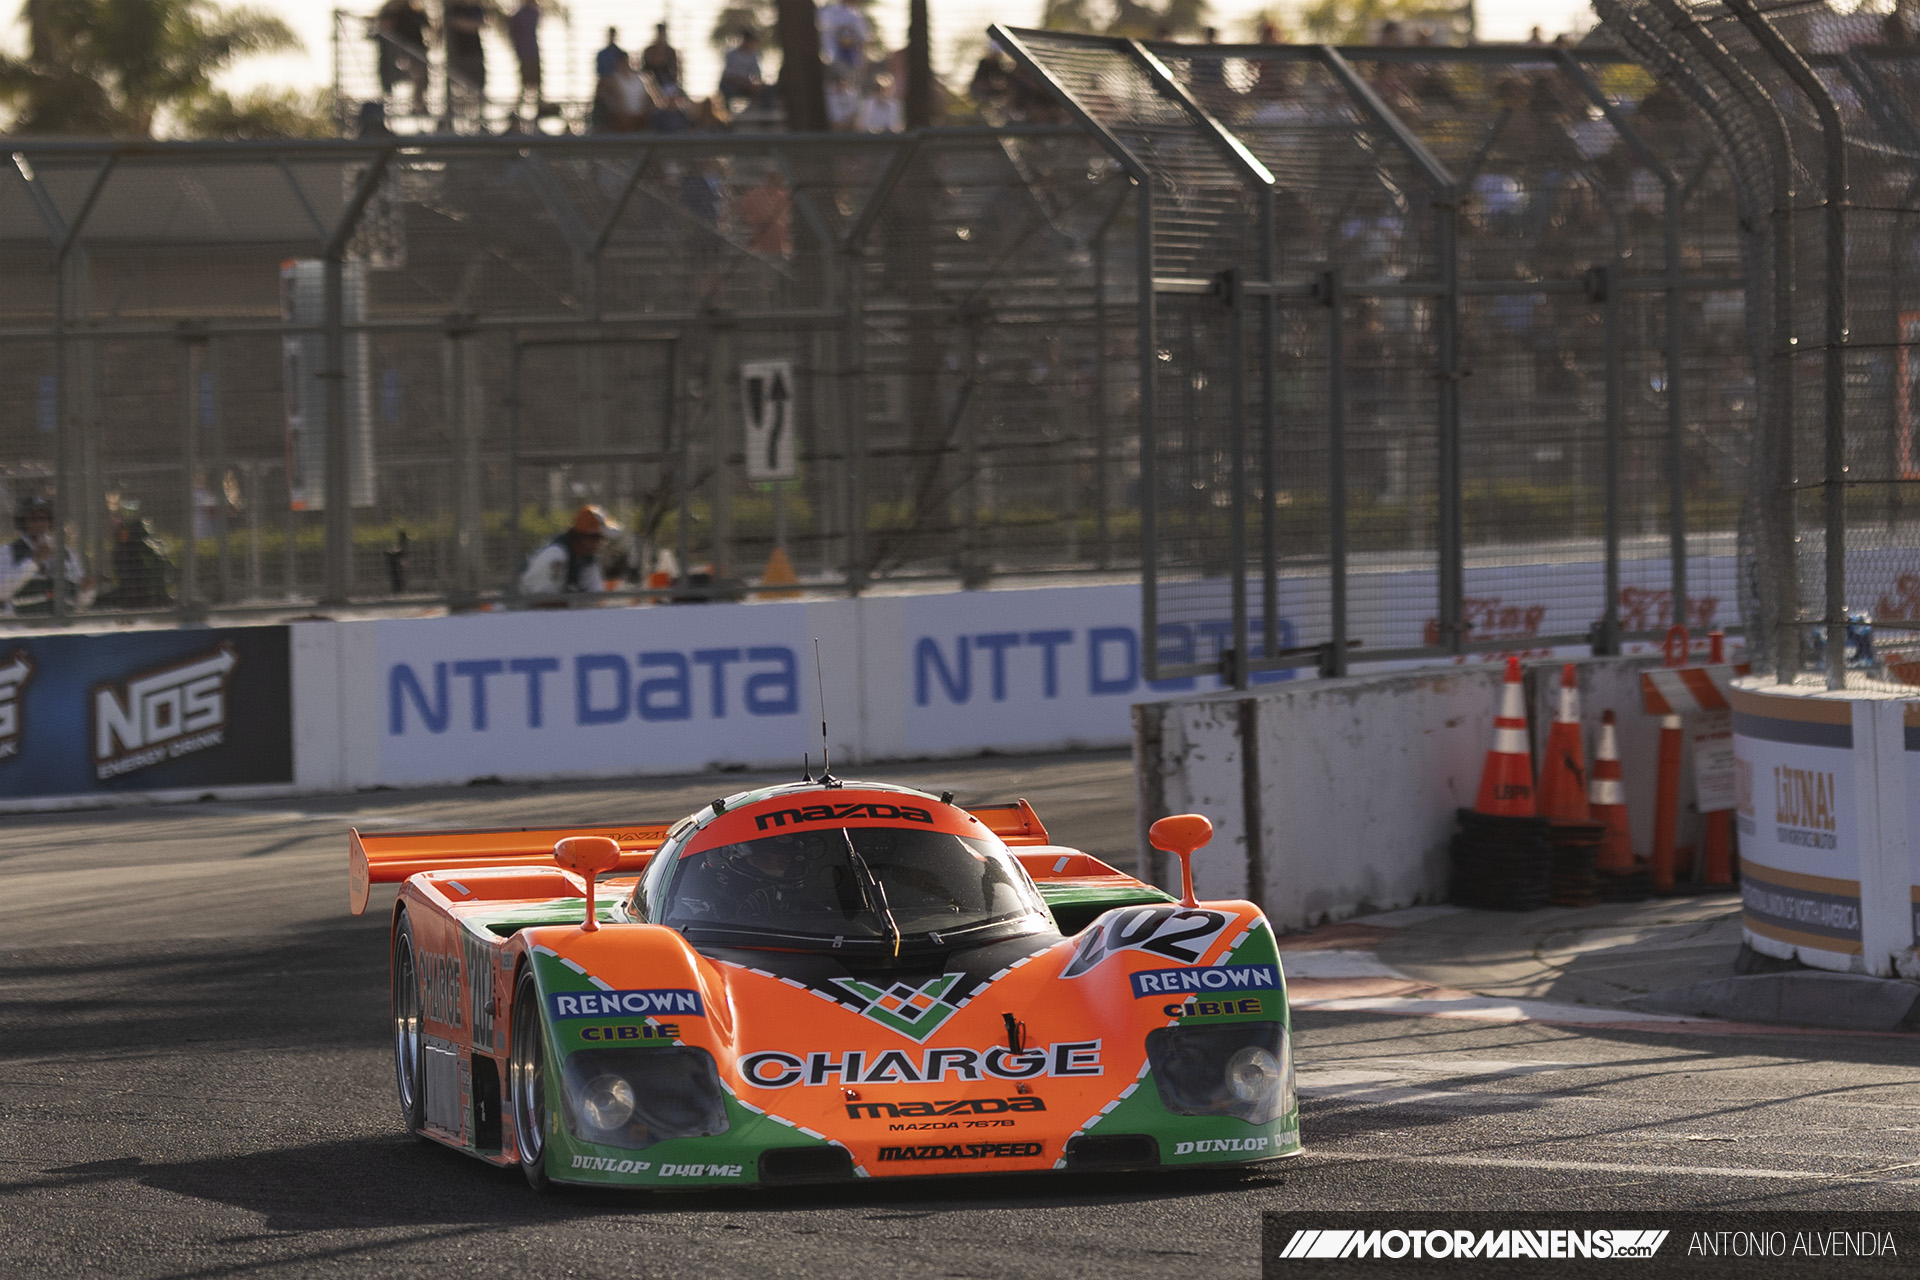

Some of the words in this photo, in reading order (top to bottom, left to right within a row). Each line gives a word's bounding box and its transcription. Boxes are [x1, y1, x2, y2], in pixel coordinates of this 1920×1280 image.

[915, 629, 1073, 706] NTT
[94, 648, 238, 759] NOS
[388, 656, 561, 737] NTT
[418, 945, 462, 1030] CHARGE
[1139, 968, 1273, 993] RENOWN
[557, 993, 696, 1015] RENOWN
[737, 1038, 1105, 1090] CHARGE
[889, 1121, 959, 1131] MAZDA
[877, 1142, 1043, 1162] MAZDASPEED
[1174, 1137, 1268, 1155] DUNLOP
[571, 1155, 651, 1174] DUNLOP
